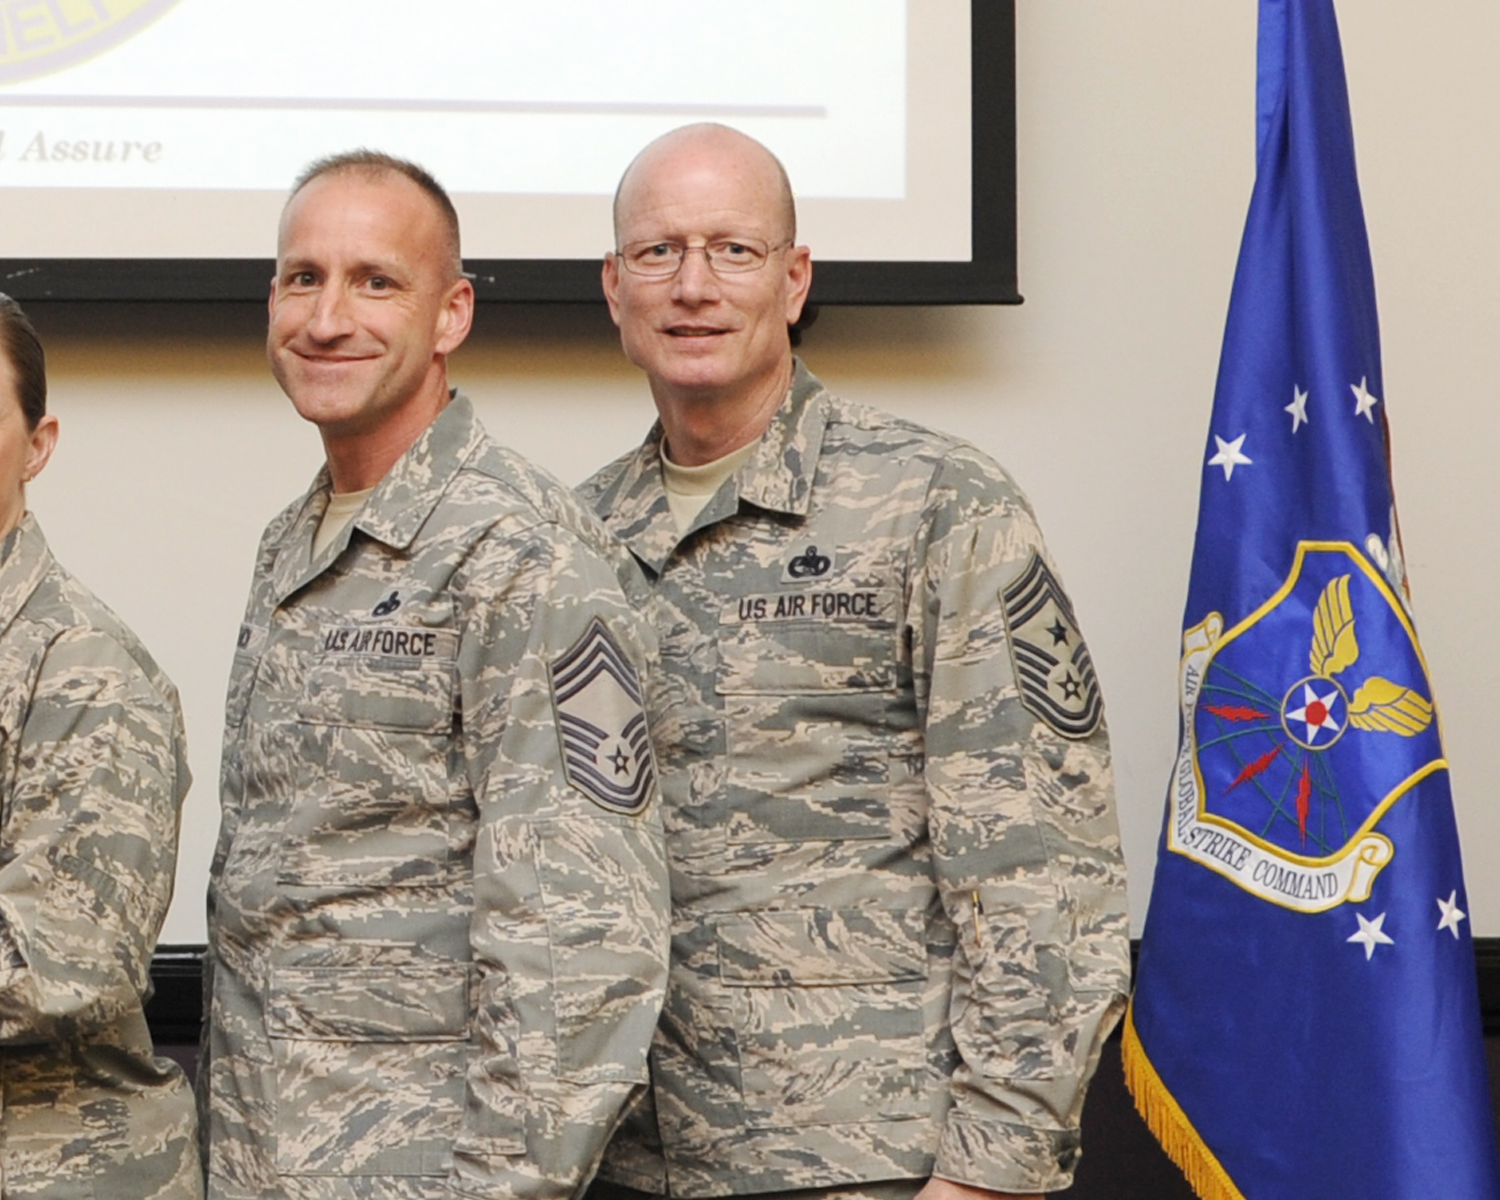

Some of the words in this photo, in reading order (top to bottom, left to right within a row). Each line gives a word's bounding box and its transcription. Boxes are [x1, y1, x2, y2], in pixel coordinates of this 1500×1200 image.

[18, 131, 162, 163] Assure
[774, 595, 806, 618] AIR
[811, 592, 878, 617] FORCE
[349, 630, 373, 652] AIR
[372, 631, 437, 656] FORCE
[1185, 664, 1200, 696] AIR
[1177, 758, 1196, 838] GLOBAL
[1182, 826, 1252, 872] STRIKE
[1253, 859, 1339, 900] COMMAND
